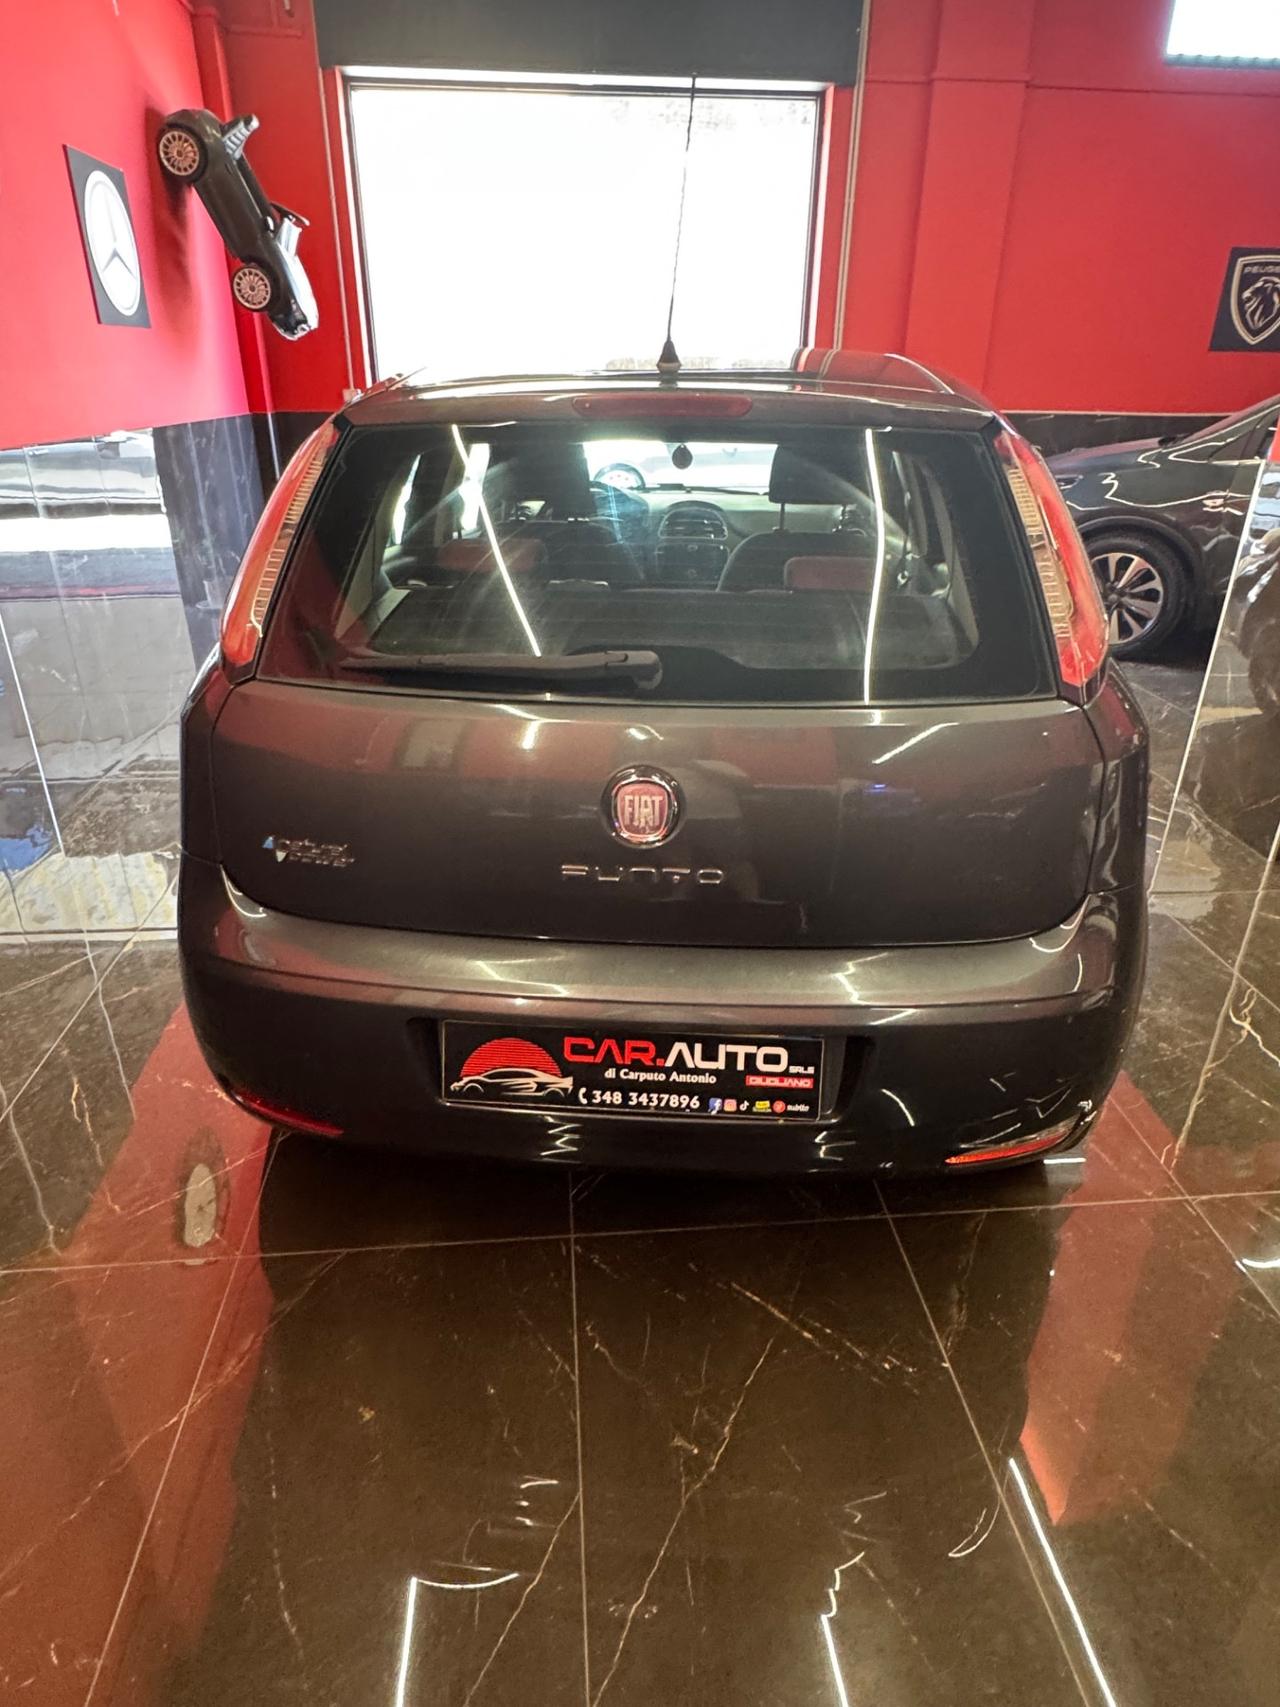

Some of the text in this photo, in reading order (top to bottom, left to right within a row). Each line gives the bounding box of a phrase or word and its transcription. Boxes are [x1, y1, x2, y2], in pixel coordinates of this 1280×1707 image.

[624, 795, 663, 827] FIAT
[561, 864, 724, 884] PUNTO
[604, 1068, 717, 1084] di Carputo Antonio
[592, 1090, 701, 1109] 348 3437896
